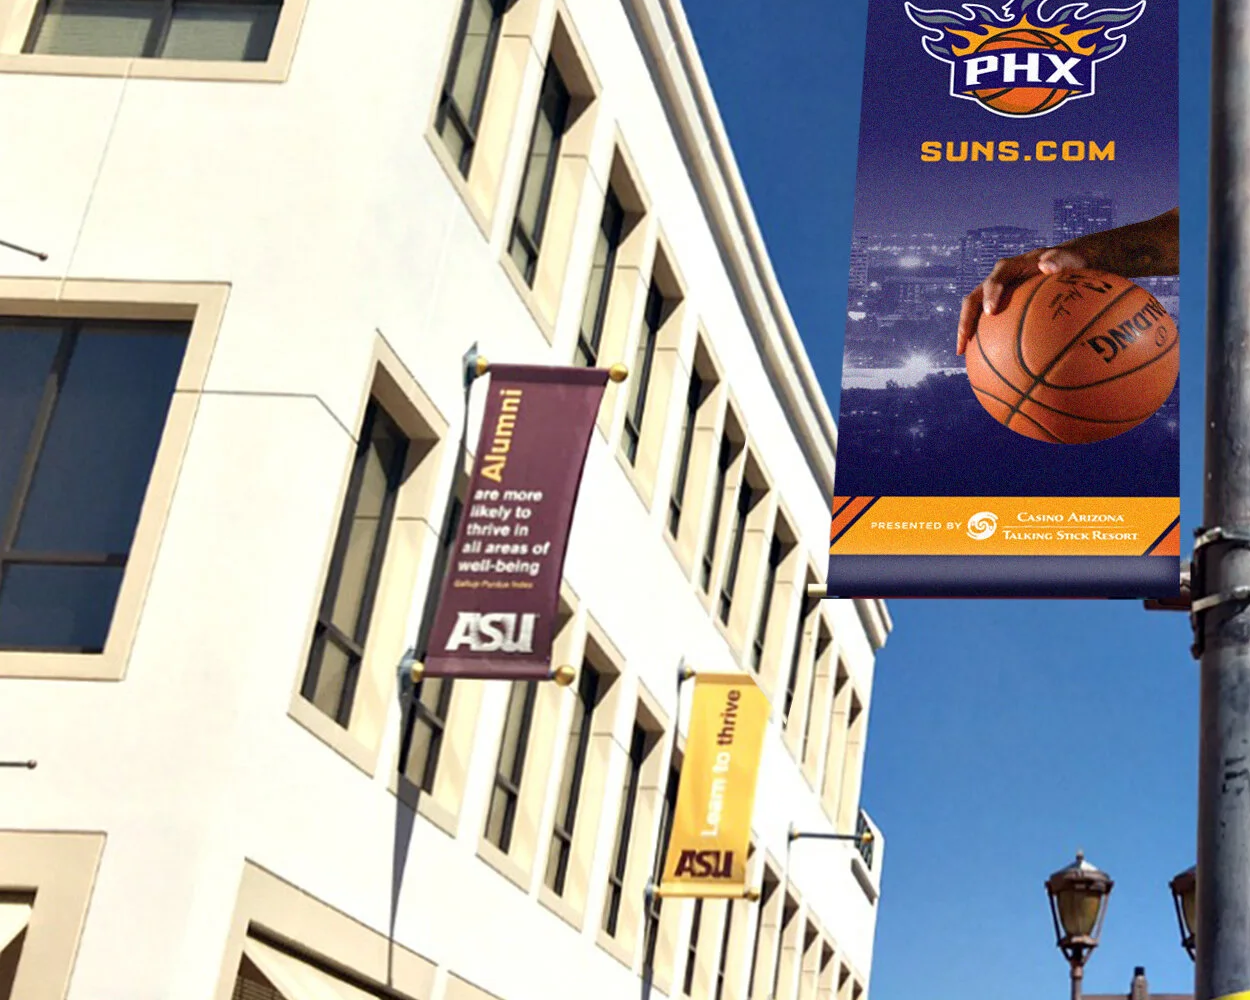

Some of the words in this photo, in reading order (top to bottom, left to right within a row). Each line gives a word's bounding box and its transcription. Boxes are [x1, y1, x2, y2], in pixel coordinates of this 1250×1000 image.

[962, 52, 1085, 86] PHX
[920, 140, 1116, 162] SUNS.COM
[481, 388, 523, 482] Alumni
[473, 489, 500, 501] are
[502, 489, 543, 502] more
[469, 504, 512, 521] likely
[515, 506, 532, 519] to
[1017, 511, 1064, 523] CASINO
[1067, 511, 1125, 523] ARIZONA
[466, 522, 511, 537] thrive
[513, 522, 529, 536] in
[871, 521, 942, 530] PRESENTED
[946, 521, 962, 530] BY
[1002, 530, 1053, 541] TALKING
[1056, 530, 1090, 541] STICK
[1092, 530, 1138, 541] RESORT
[461, 540, 482, 554] all
[484, 542, 529, 555] areas
[531, 541, 551, 556] of
[457, 559, 540, 577] well-being
[444, 611, 536, 653] ASU
[716, 689, 742, 746] thrive
[712, 751, 731, 774] to
[700, 777, 728, 837] Learn
[673, 849, 735, 878] ASU
